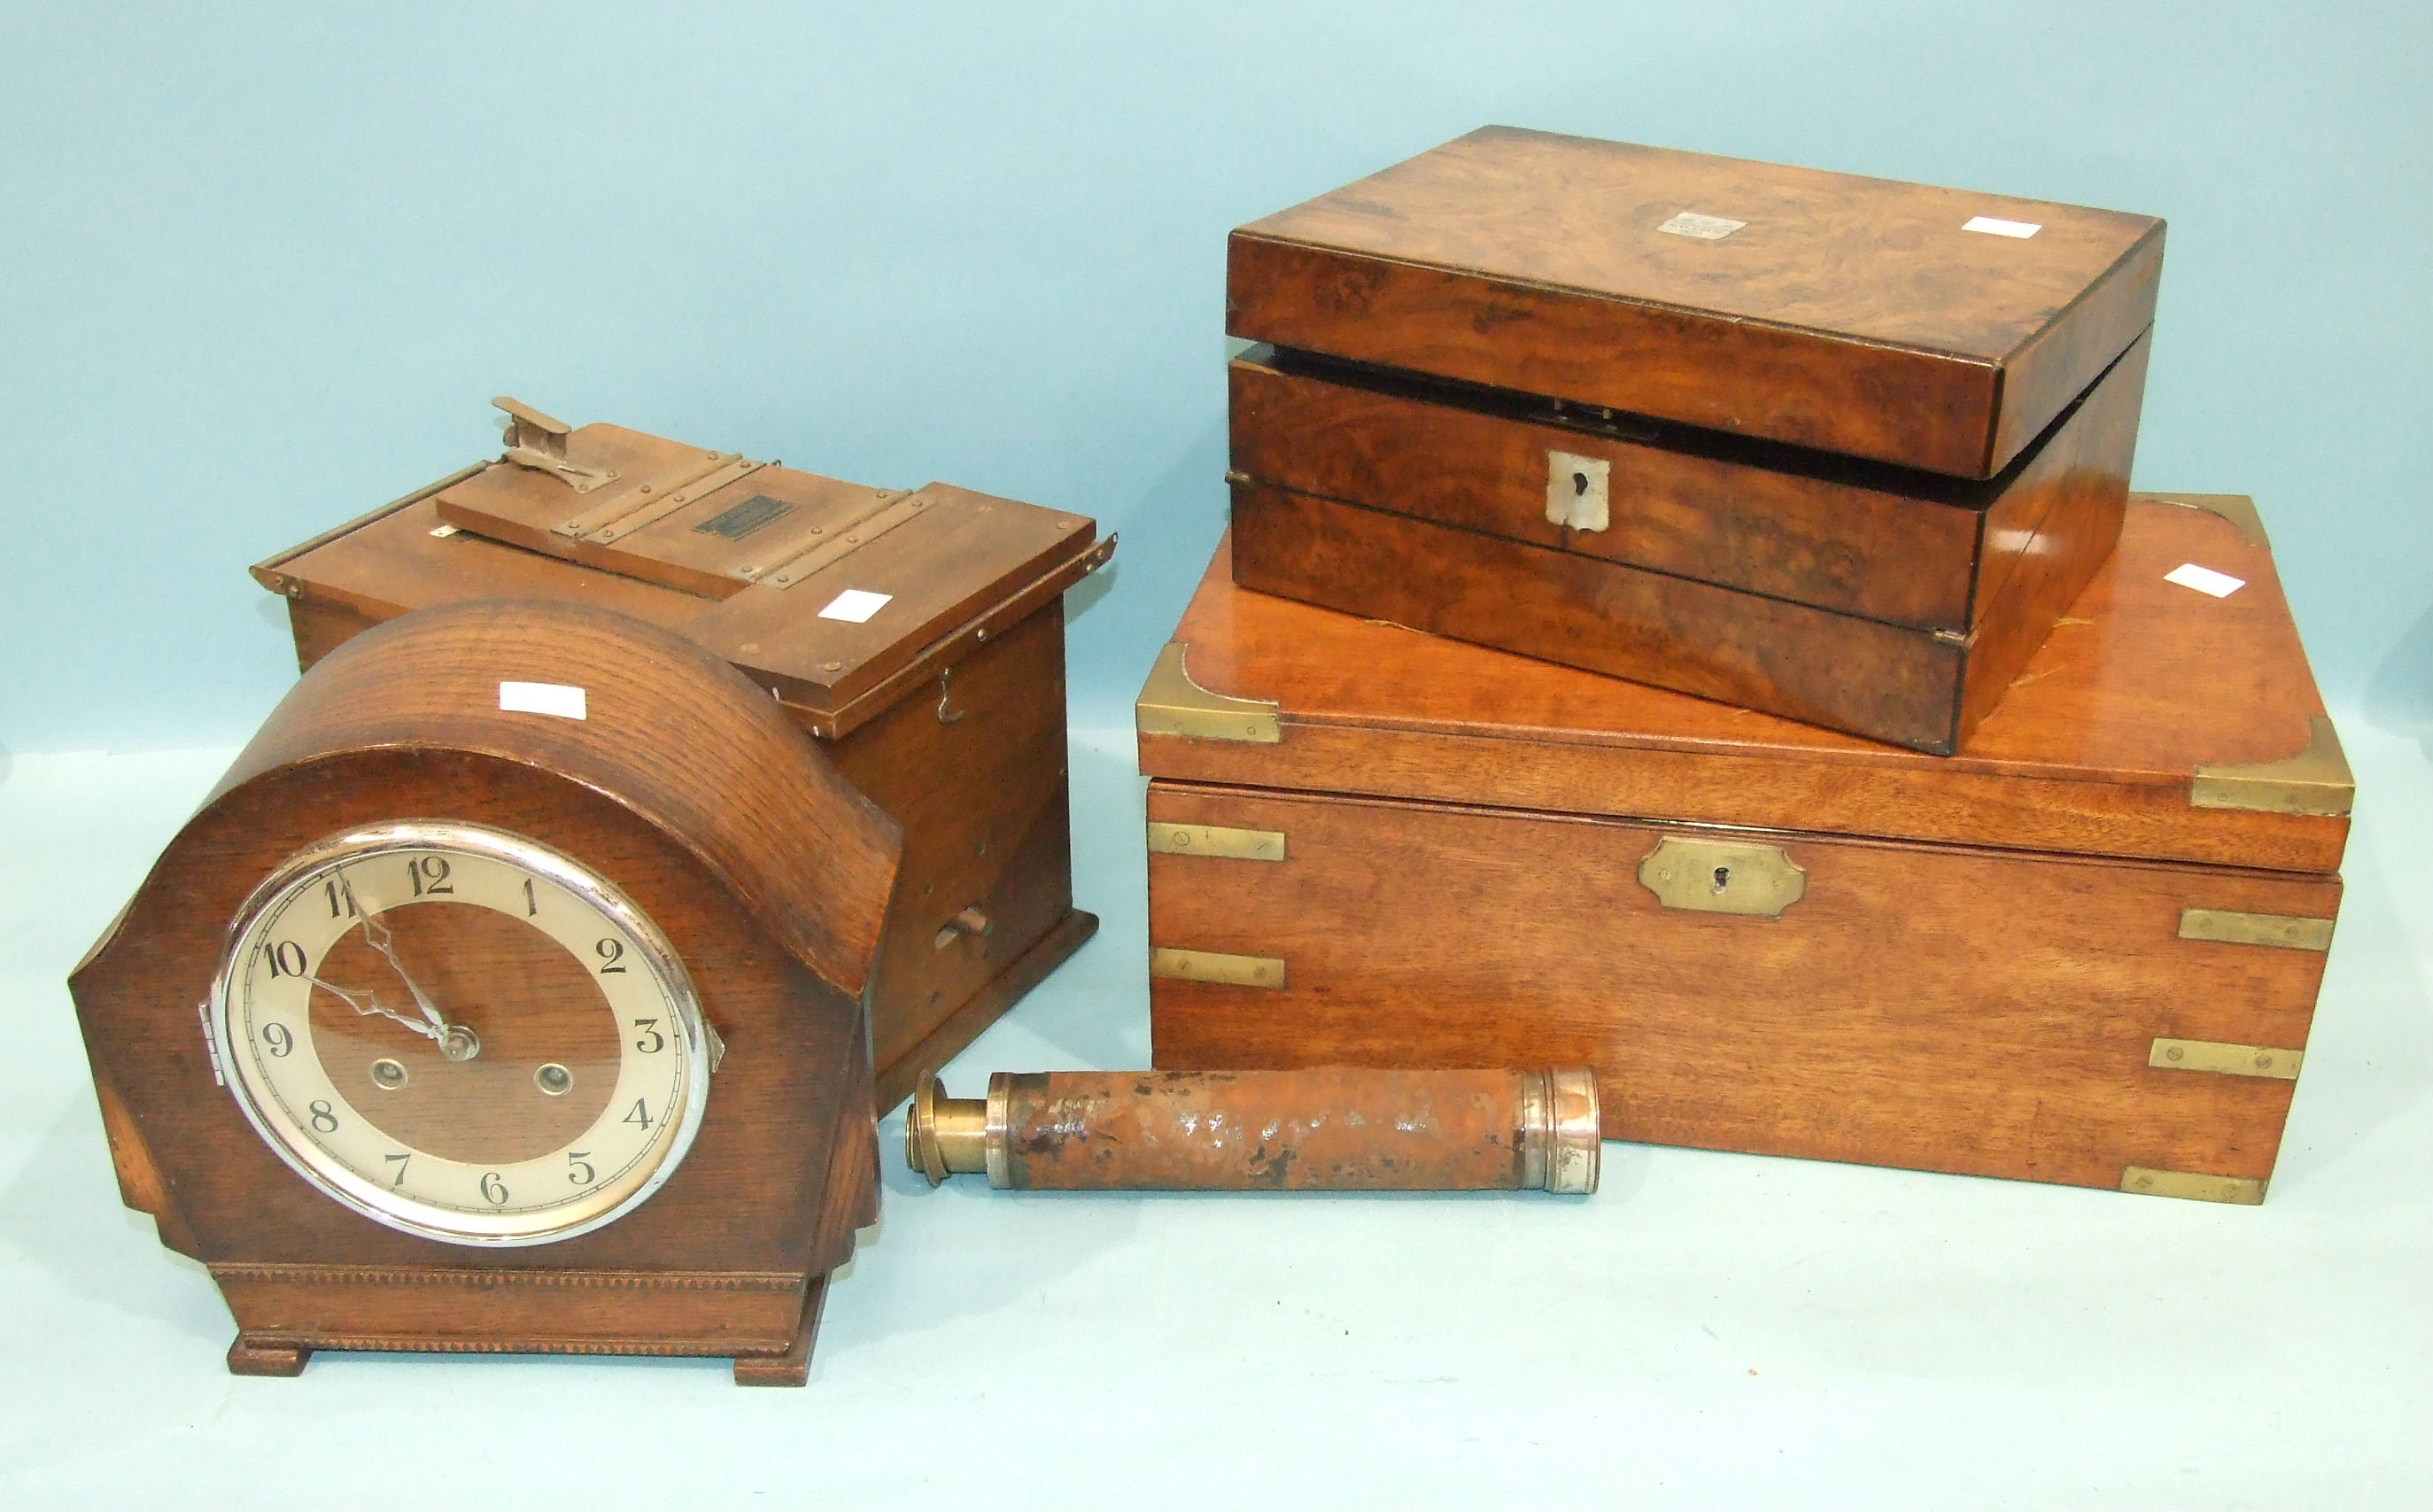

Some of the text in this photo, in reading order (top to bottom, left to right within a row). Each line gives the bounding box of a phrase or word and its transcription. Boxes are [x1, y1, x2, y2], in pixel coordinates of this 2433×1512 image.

[408, 857, 453, 896] 12
[325, 879, 356, 919] 11
[523, 879, 537, 917] 1
[264, 940, 307, 978] 10
[596, 937, 627, 973] 2
[263, 1022, 293, 1057] 9
[635, 1019, 664, 1053] 3
[310, 1099, 338, 1133] 8
[623, 1097, 654, 1131] 4
[385, 1153, 411, 1186] 7
[569, 1152, 595, 1184] 5
[481, 1173, 508, 1206] 6
